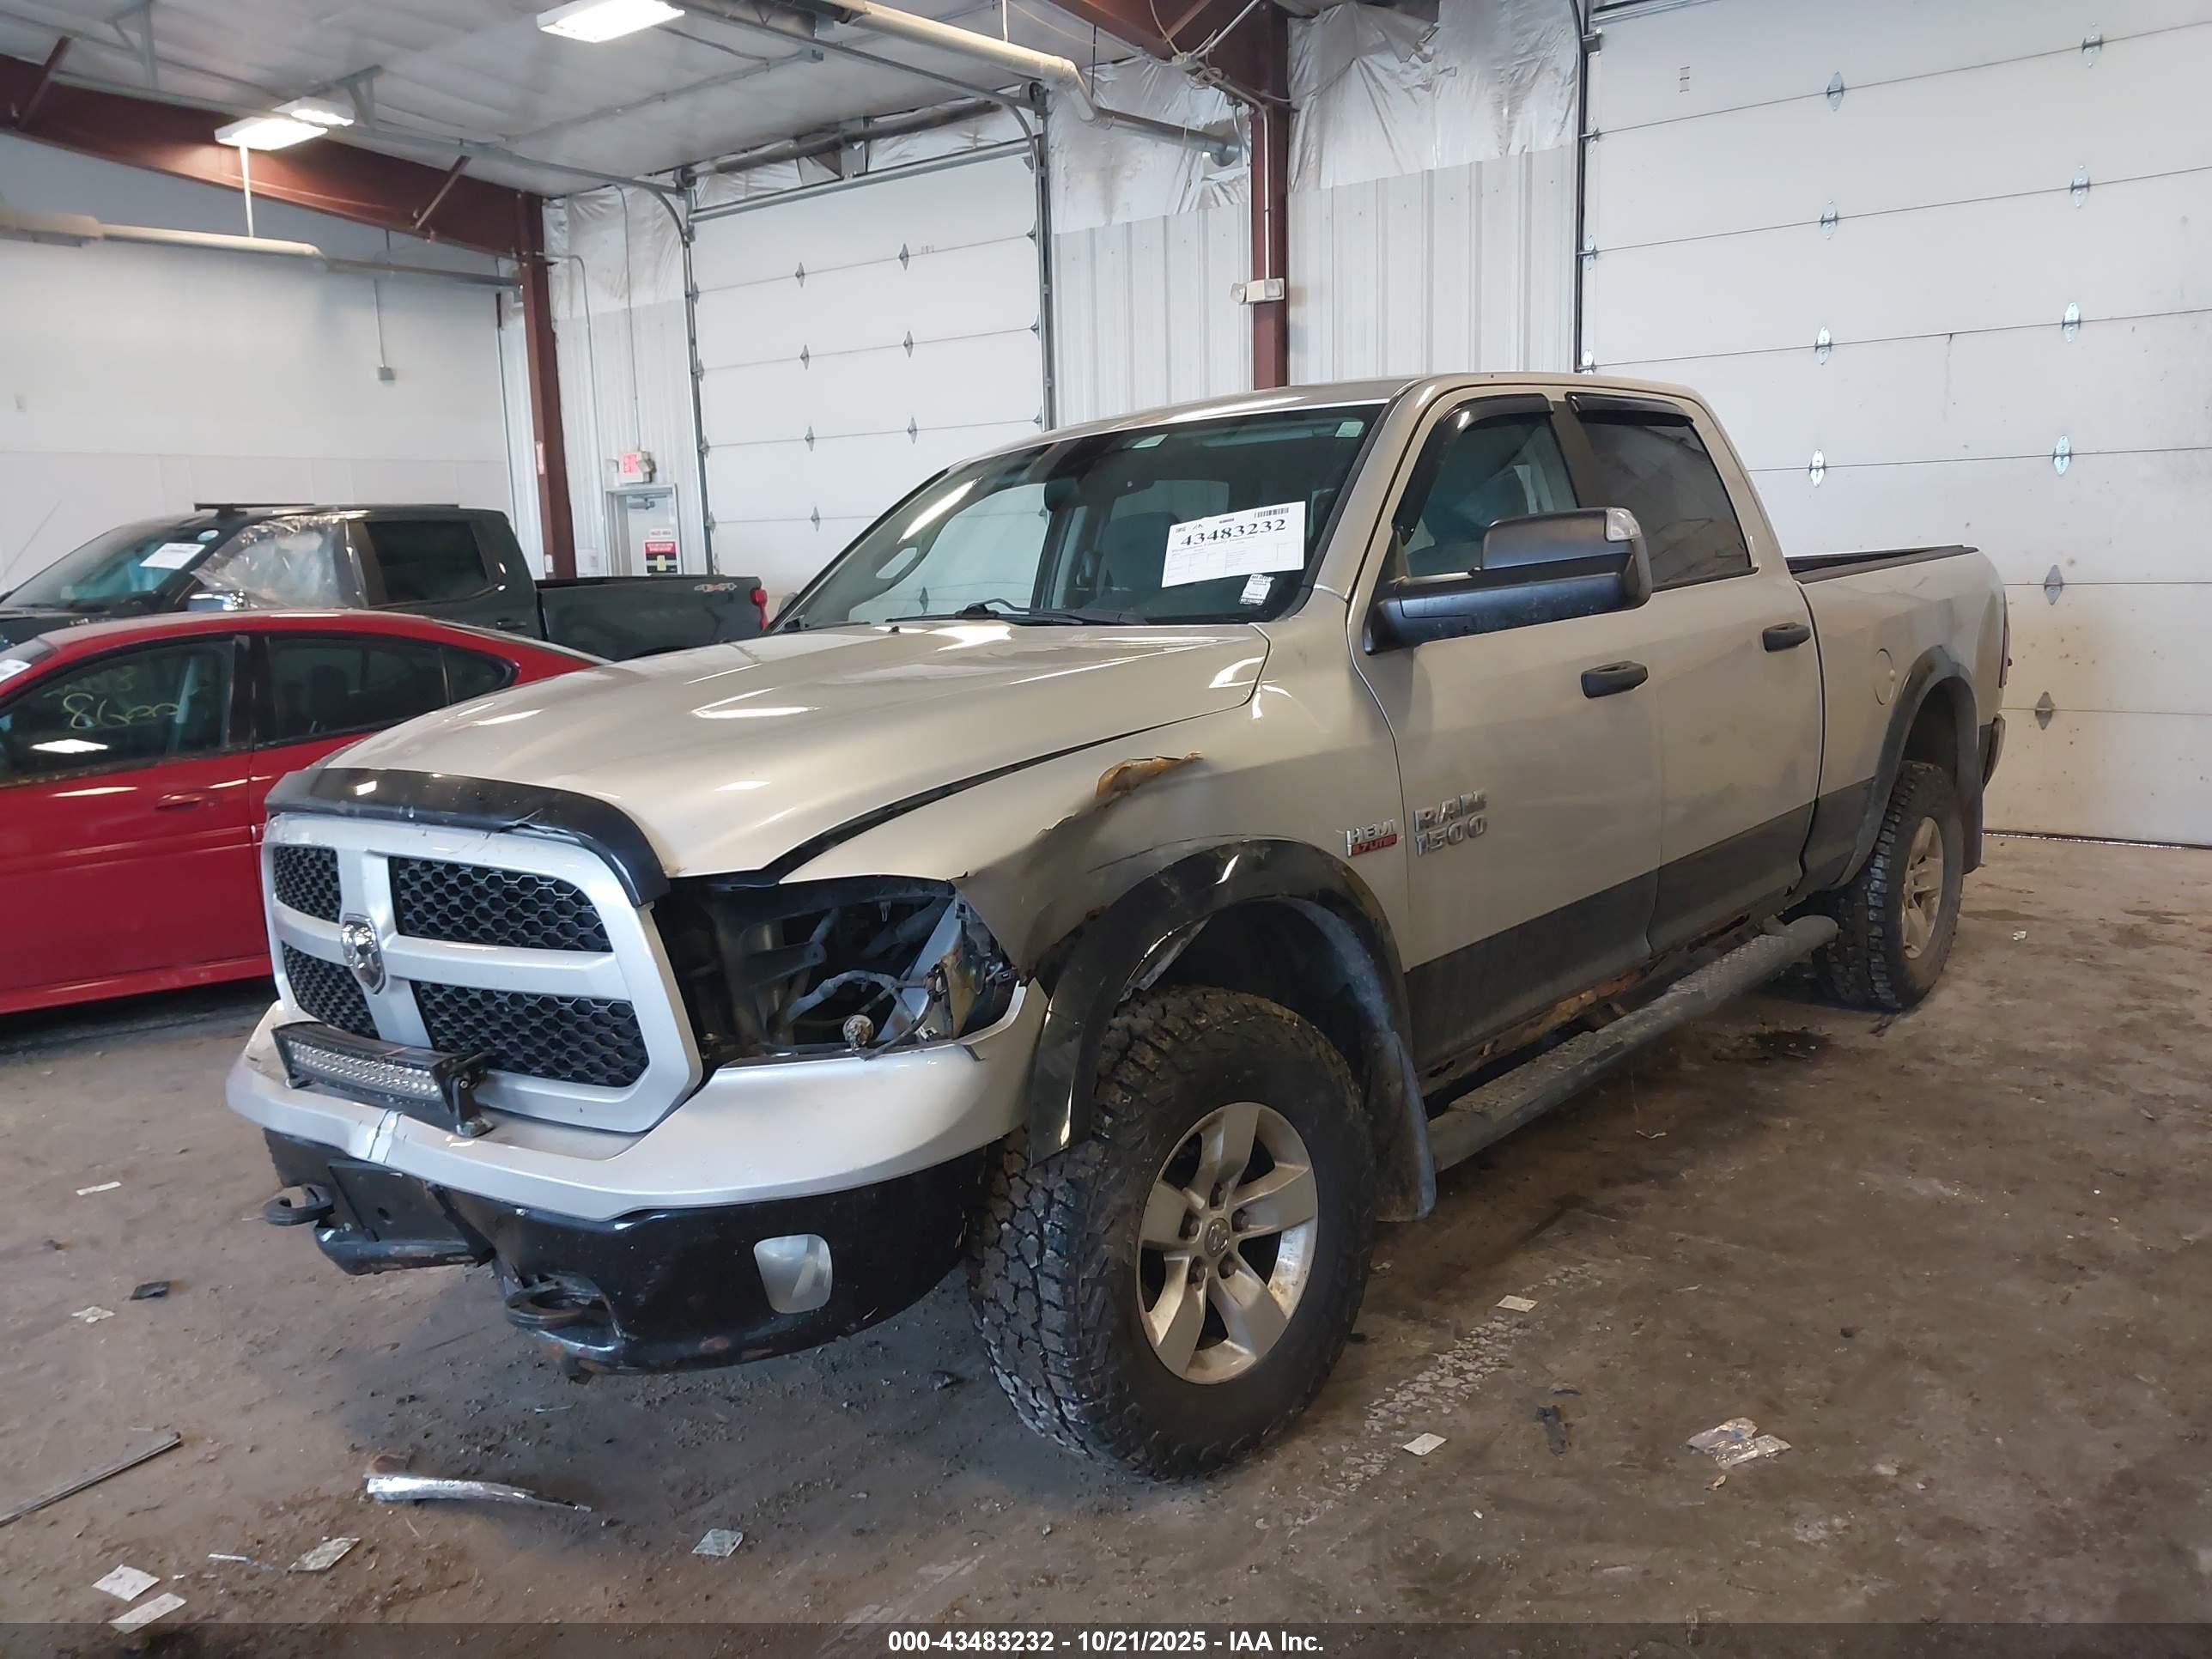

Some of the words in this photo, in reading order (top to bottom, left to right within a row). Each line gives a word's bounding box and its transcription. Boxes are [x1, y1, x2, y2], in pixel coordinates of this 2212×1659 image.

[1180, 519, 1286, 546] 43483232
[1413, 788, 1487, 831] RAM
[1346, 818, 1395, 844] HEMI
[1415, 813, 1487, 857] 1500
